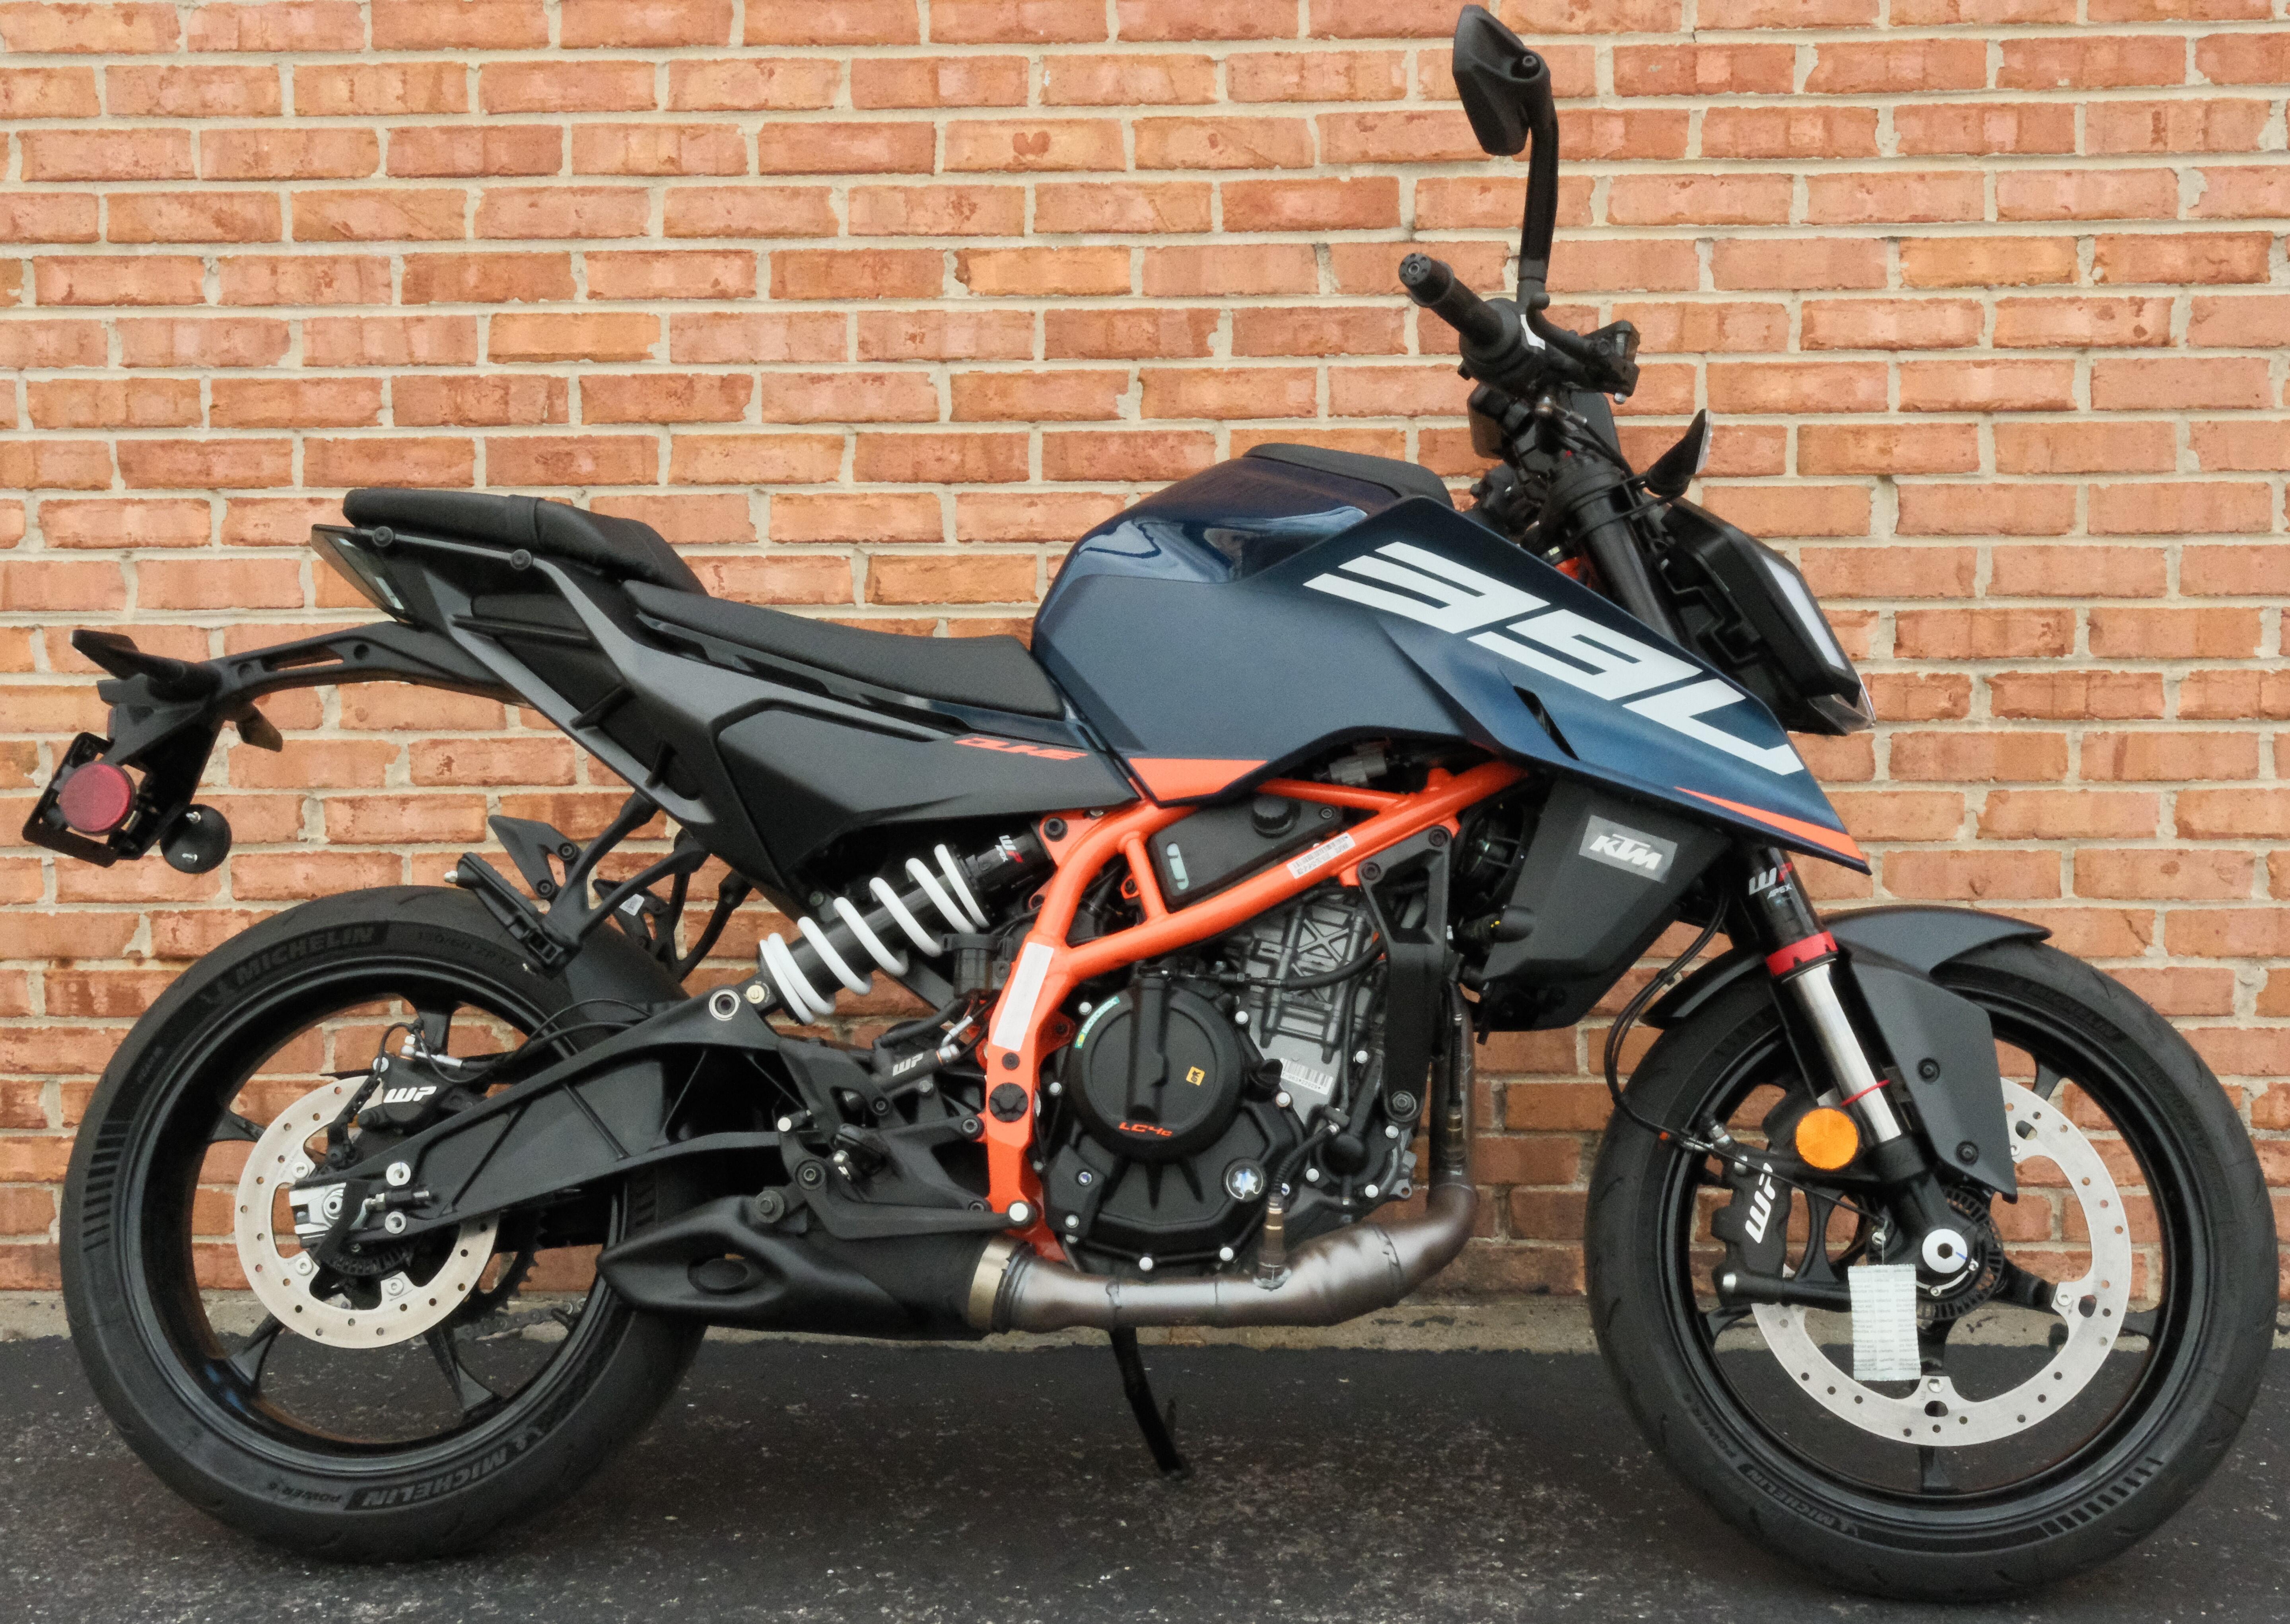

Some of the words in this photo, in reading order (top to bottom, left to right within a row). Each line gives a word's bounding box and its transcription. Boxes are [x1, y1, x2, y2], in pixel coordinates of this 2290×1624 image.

[954, 737, 1089, 760] DUKE
[1589, 834, 1663, 870] KTM
[1749, 862, 1793, 896] WP
[239, 926, 374, 982] MICHELIN
[892, 1053, 923, 1077] WP
[383, 1086, 437, 1103] WP
[1745, 1162, 1775, 1243] WP
[284, 1482, 342, 1504] POWER
[361, 1447, 507, 1506] MICHELIN
